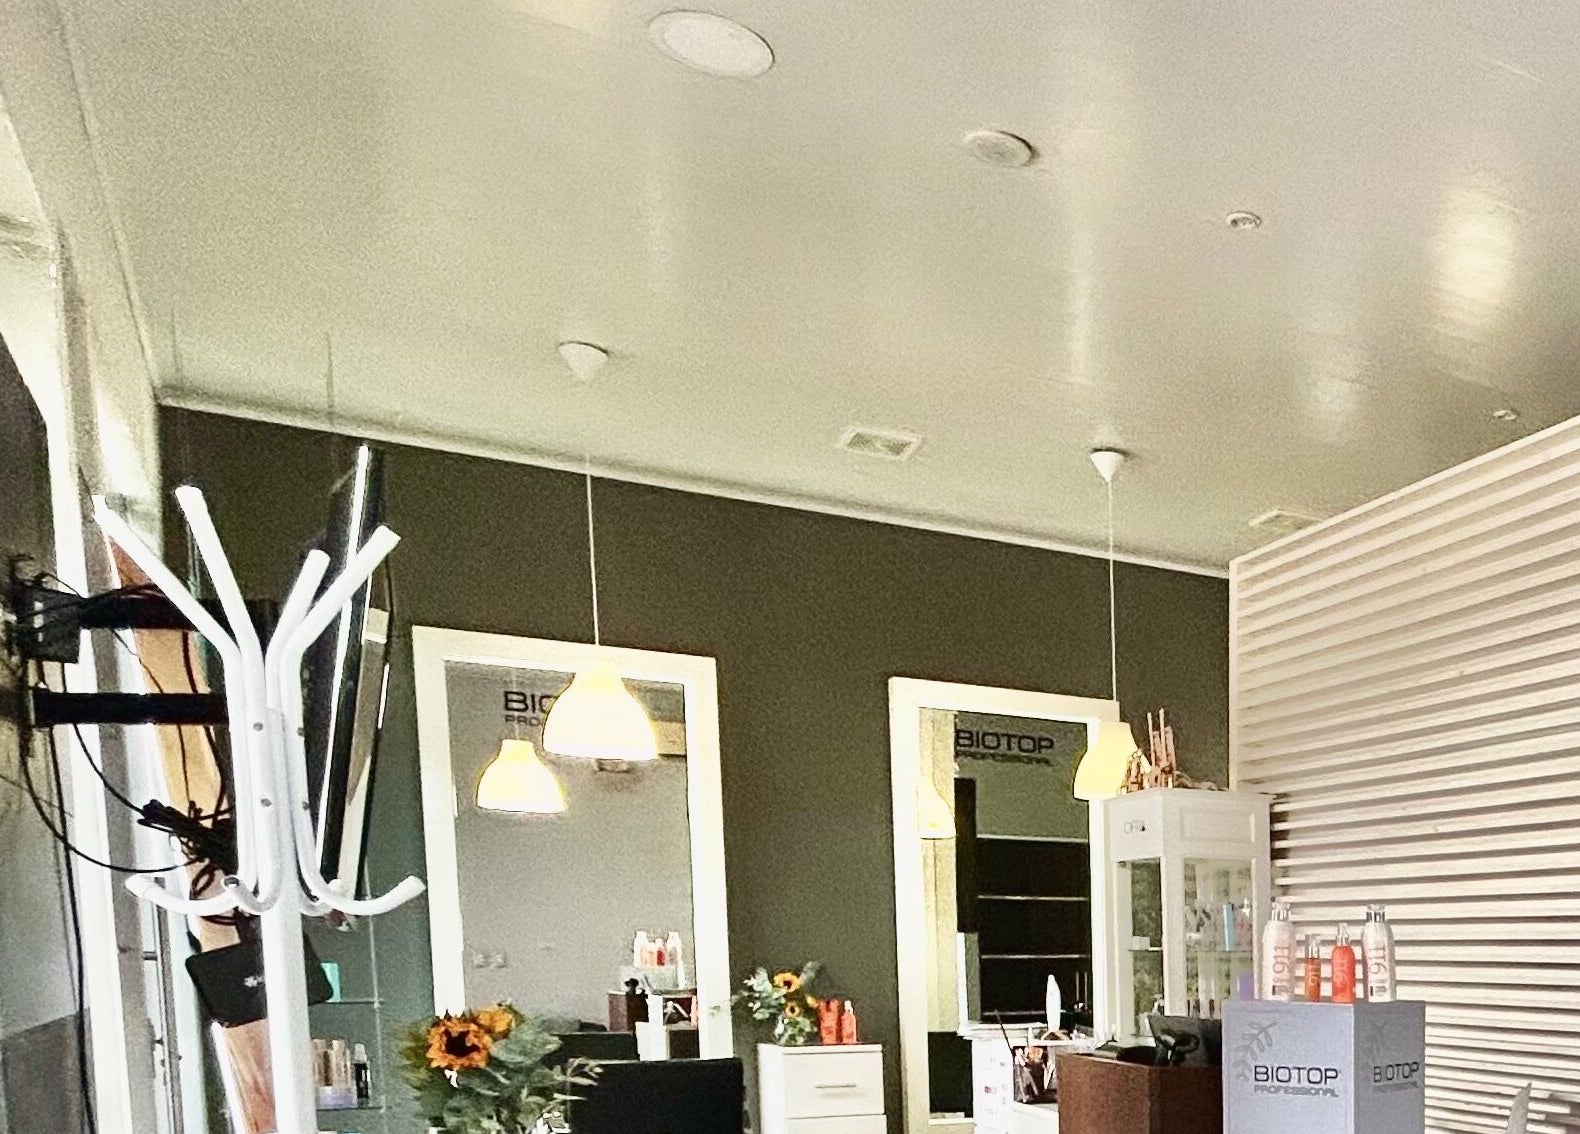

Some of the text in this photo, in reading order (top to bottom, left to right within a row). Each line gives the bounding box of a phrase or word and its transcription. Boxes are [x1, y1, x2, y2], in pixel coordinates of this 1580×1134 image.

[956, 729, 1054, 754] BIOTOP
[1254, 1065, 1339, 1085] BIOTOP
[1373, 1062, 1420, 1083] BIOTOP
